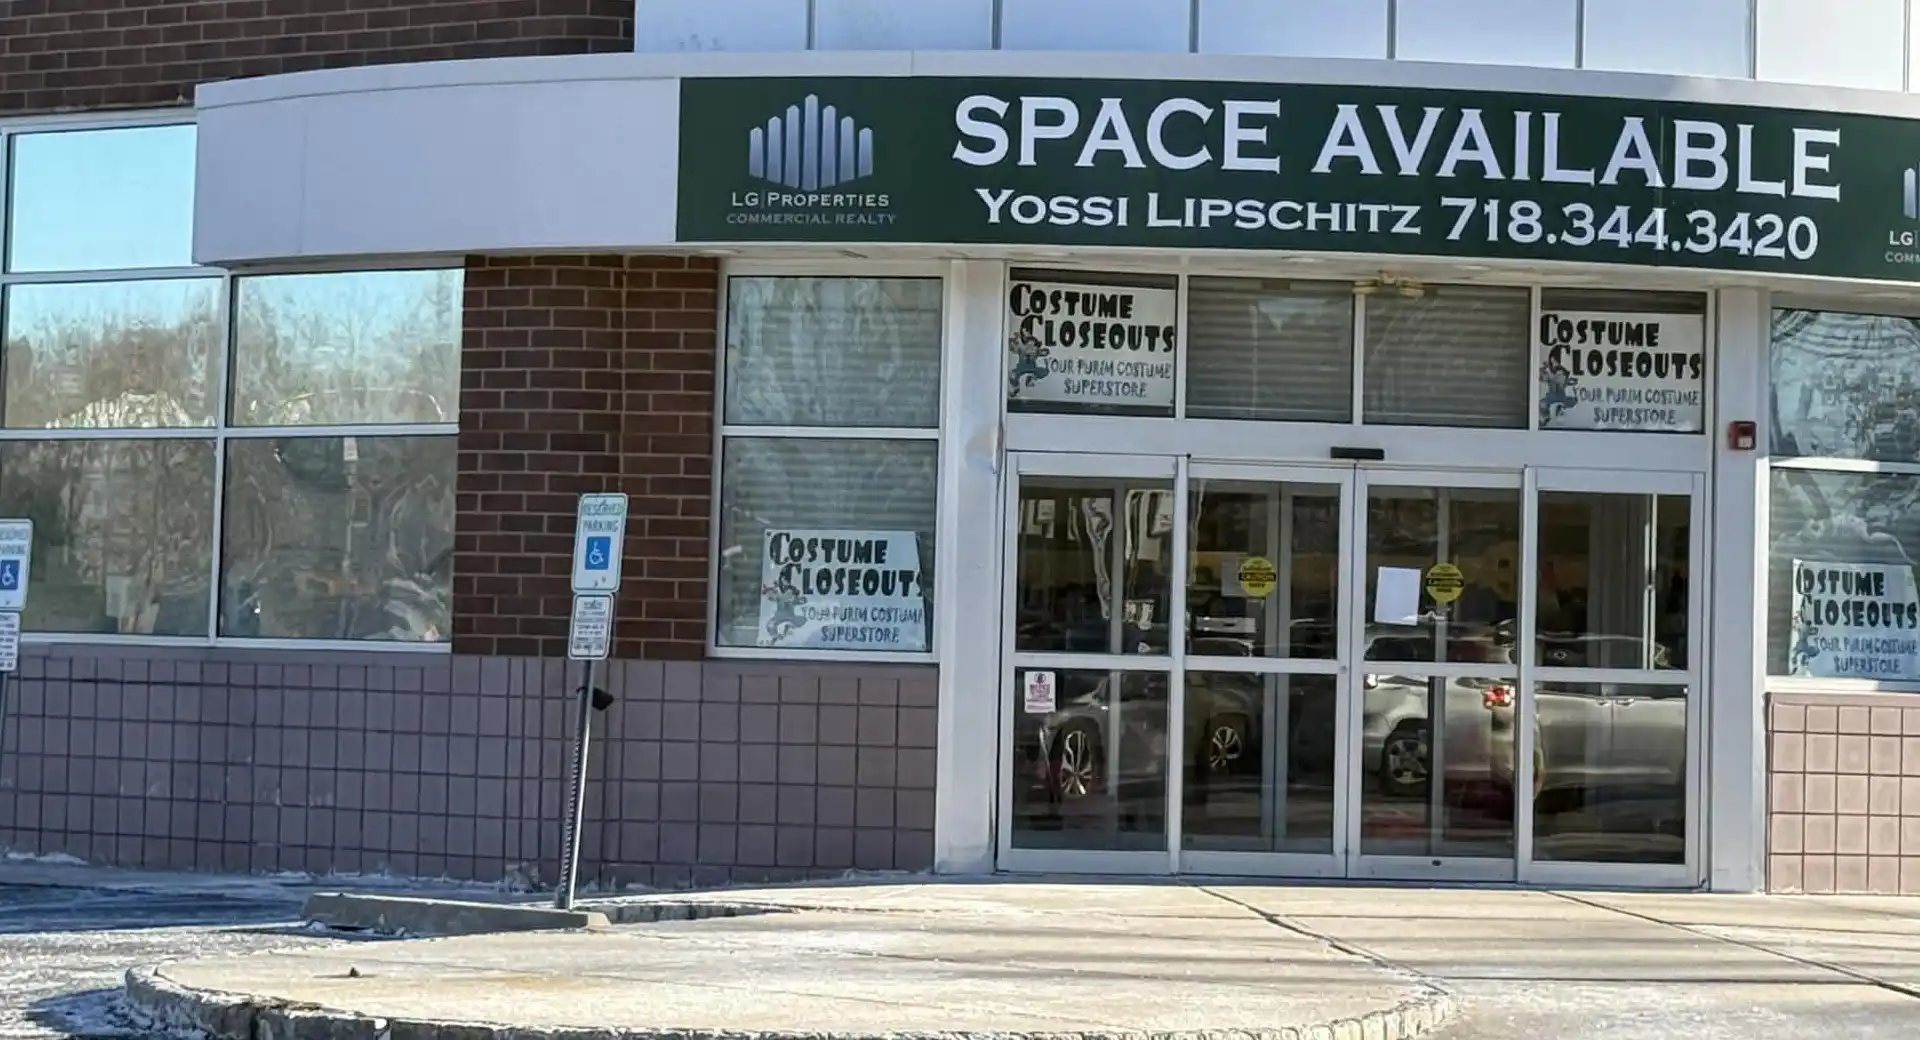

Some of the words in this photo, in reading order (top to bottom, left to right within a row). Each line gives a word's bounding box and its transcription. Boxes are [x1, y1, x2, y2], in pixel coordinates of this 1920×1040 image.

[953, 94, 1281, 174] SPACE
[1311, 103, 1841, 202] AVAILABLE
[732, 192, 759, 207] LG
[768, 192, 889, 208] PROPERTIES
[726, 213, 831, 225] COMMERCIAL
[835, 213, 896, 225] REALTY
[975, 188, 1129, 230] YOSSI
[1146, 192, 1422, 235] LIPSCHITZ
[1441, 197, 1819, 260] 718.344.3420
[1889, 230, 1914, 246] LG
[1010, 283, 1134, 319] COSTUME
[1020, 314, 1174, 353] CLOSEOUTS
[1540, 313, 1660, 347] COSTUME
[1116, 361, 1172, 379] COSTUME
[1548, 344, 1701, 380] CLOSEOUTS
[1063, 377, 1148, 398] SUPERSTORE
[1644, 388, 1700, 407] COSTUME
[1593, 407, 1677, 426] SUPERSTORE
[769, 532, 889, 565] COSTUME
[1800, 593, 1918, 630] CLOSEOUTS
[821, 625, 900, 643] SUPERSTORE
